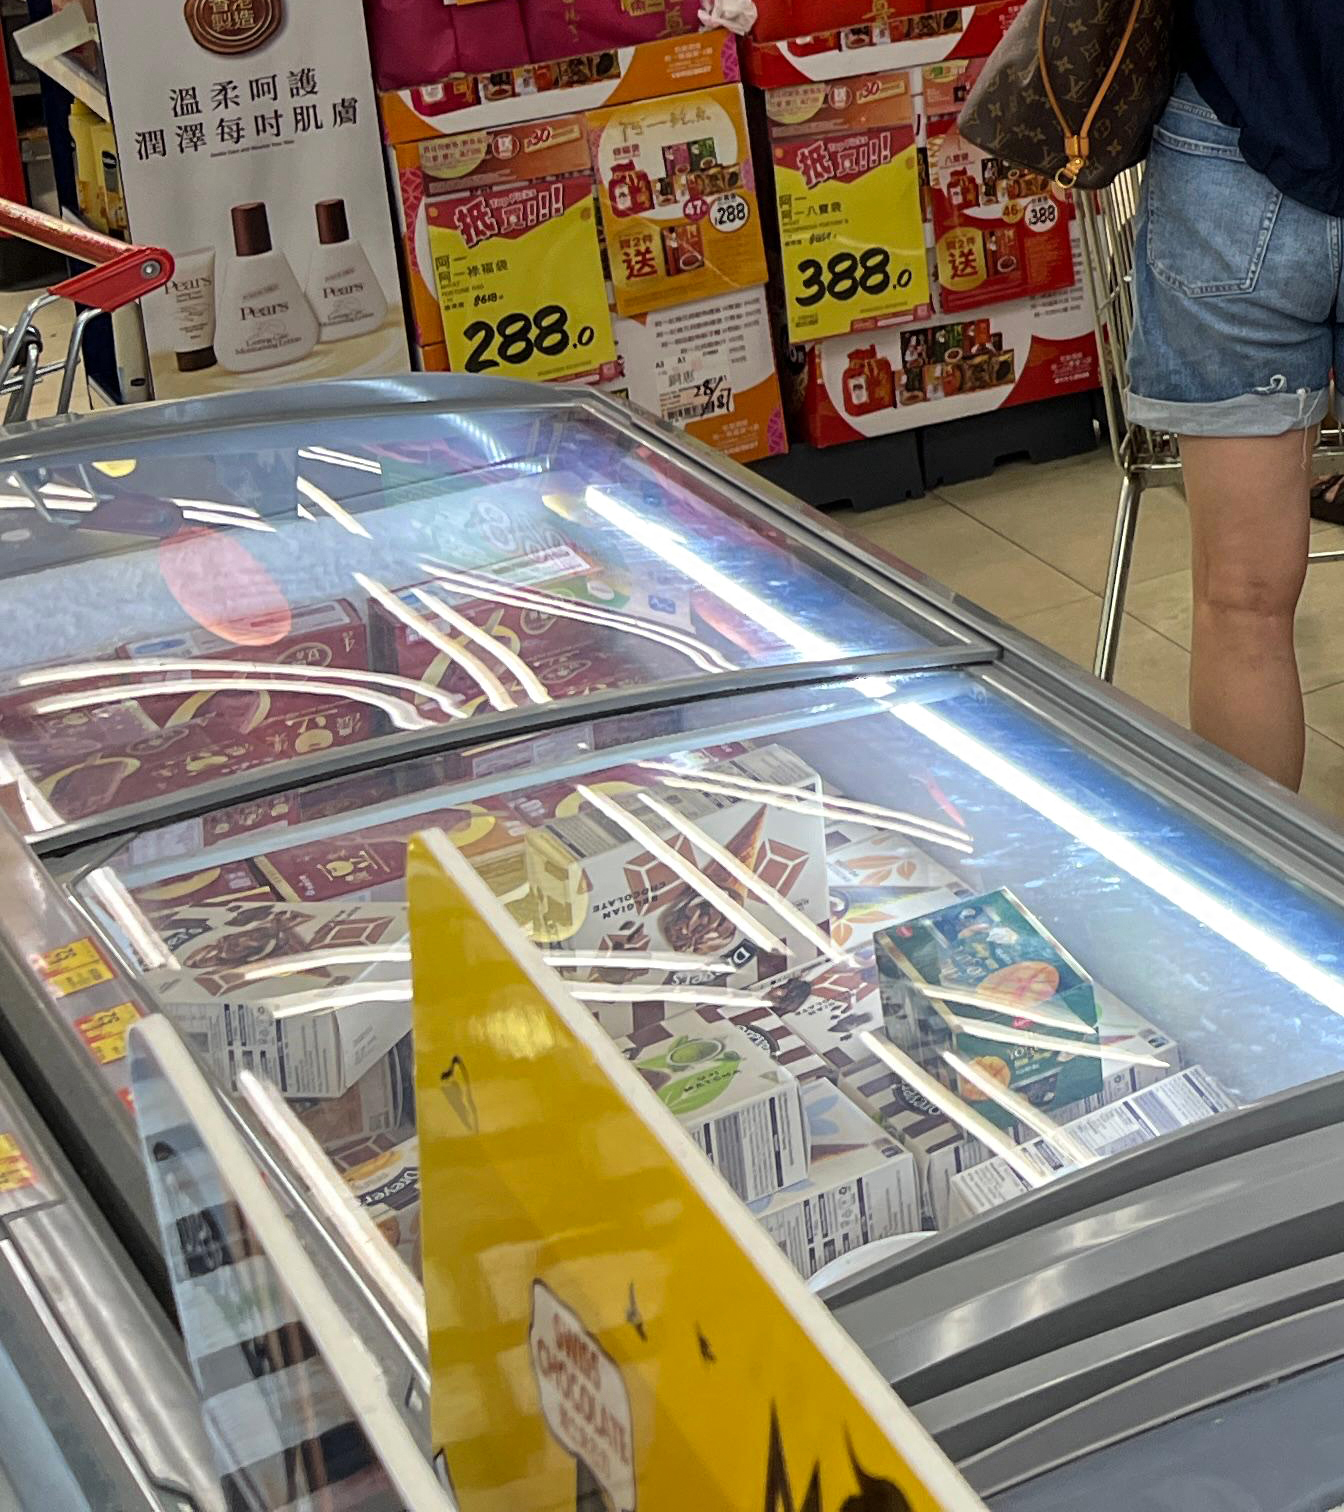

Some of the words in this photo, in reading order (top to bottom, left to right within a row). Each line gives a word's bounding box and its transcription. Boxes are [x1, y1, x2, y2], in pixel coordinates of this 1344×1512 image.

[168, 67, 320, 119] 溫柔呵護
[135, 96, 359, 161] 潤澤每吋肌膚
[622, 247, 658, 280] 送
[794, 247, 913, 307] 388.0
[949, 249, 979, 280] 送
[463, 305, 595, 373] 288.0
